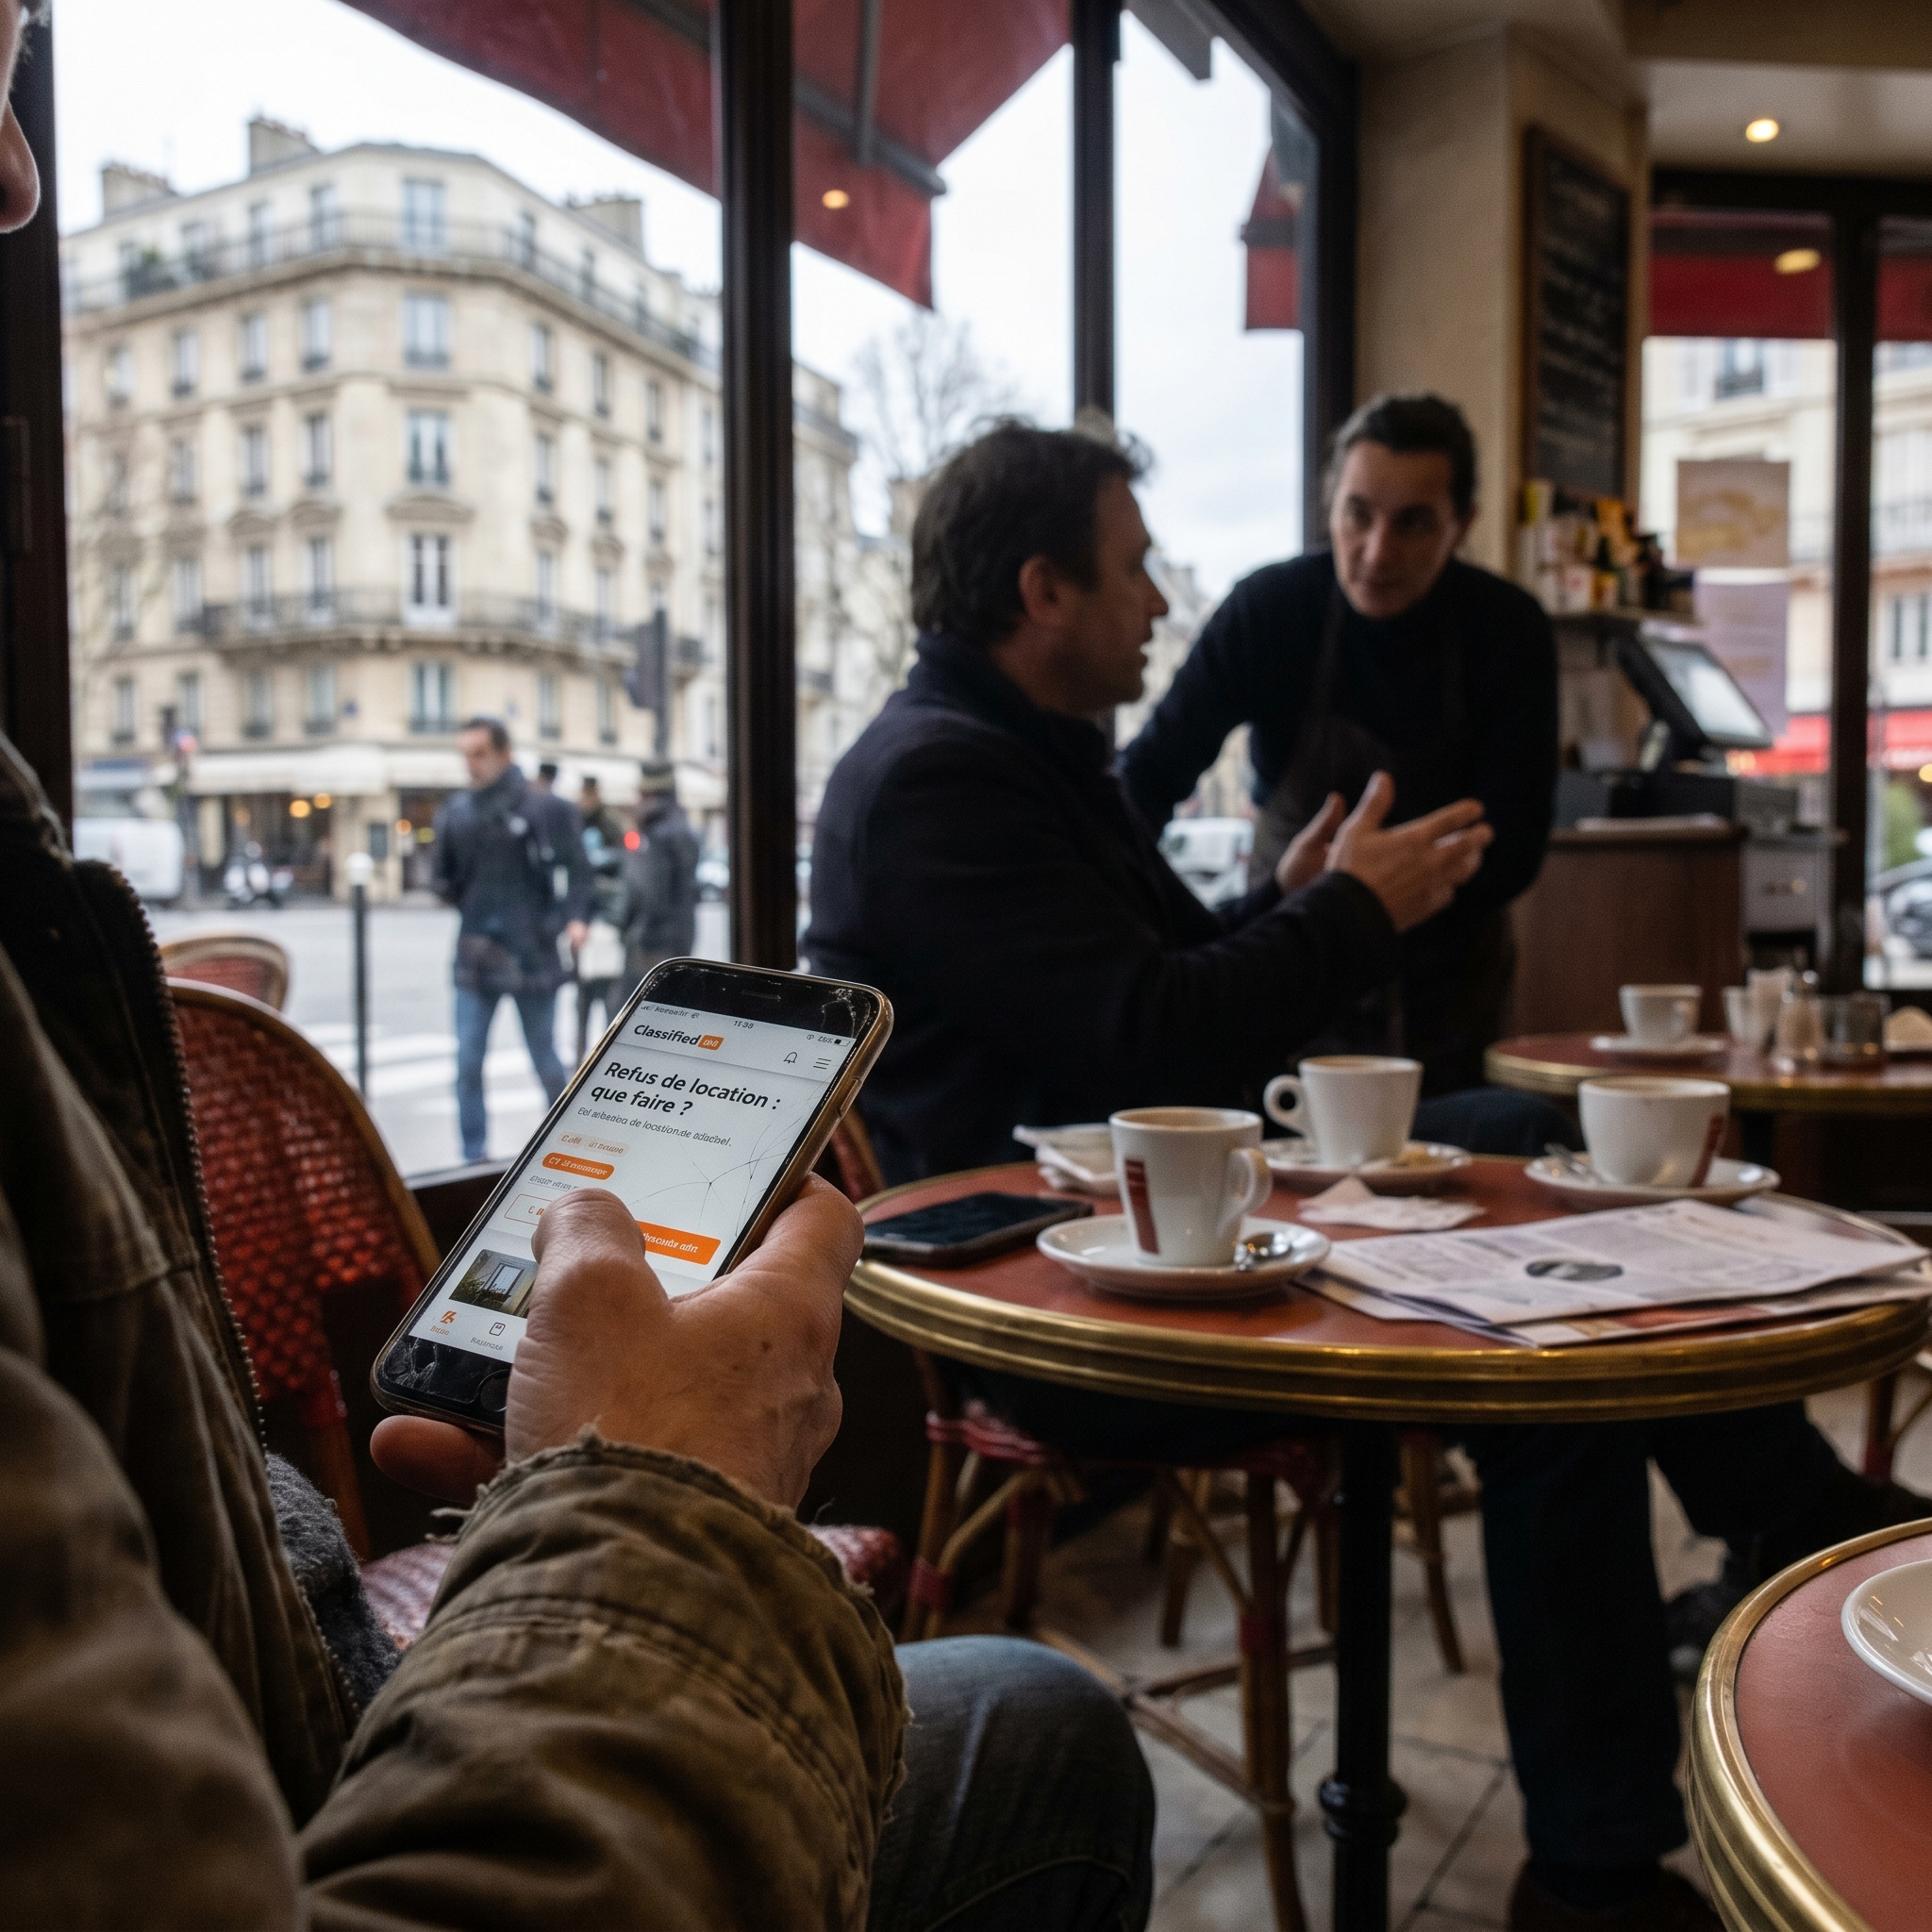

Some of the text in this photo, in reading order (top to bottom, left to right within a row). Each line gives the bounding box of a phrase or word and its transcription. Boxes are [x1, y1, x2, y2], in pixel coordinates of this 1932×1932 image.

[633, 1024, 702, 1046] Classified
[604, 1061, 781, 1110] Refus de location :
[591, 1086, 693, 1116] que faire ?
[629, 1119, 641, 1127] de
